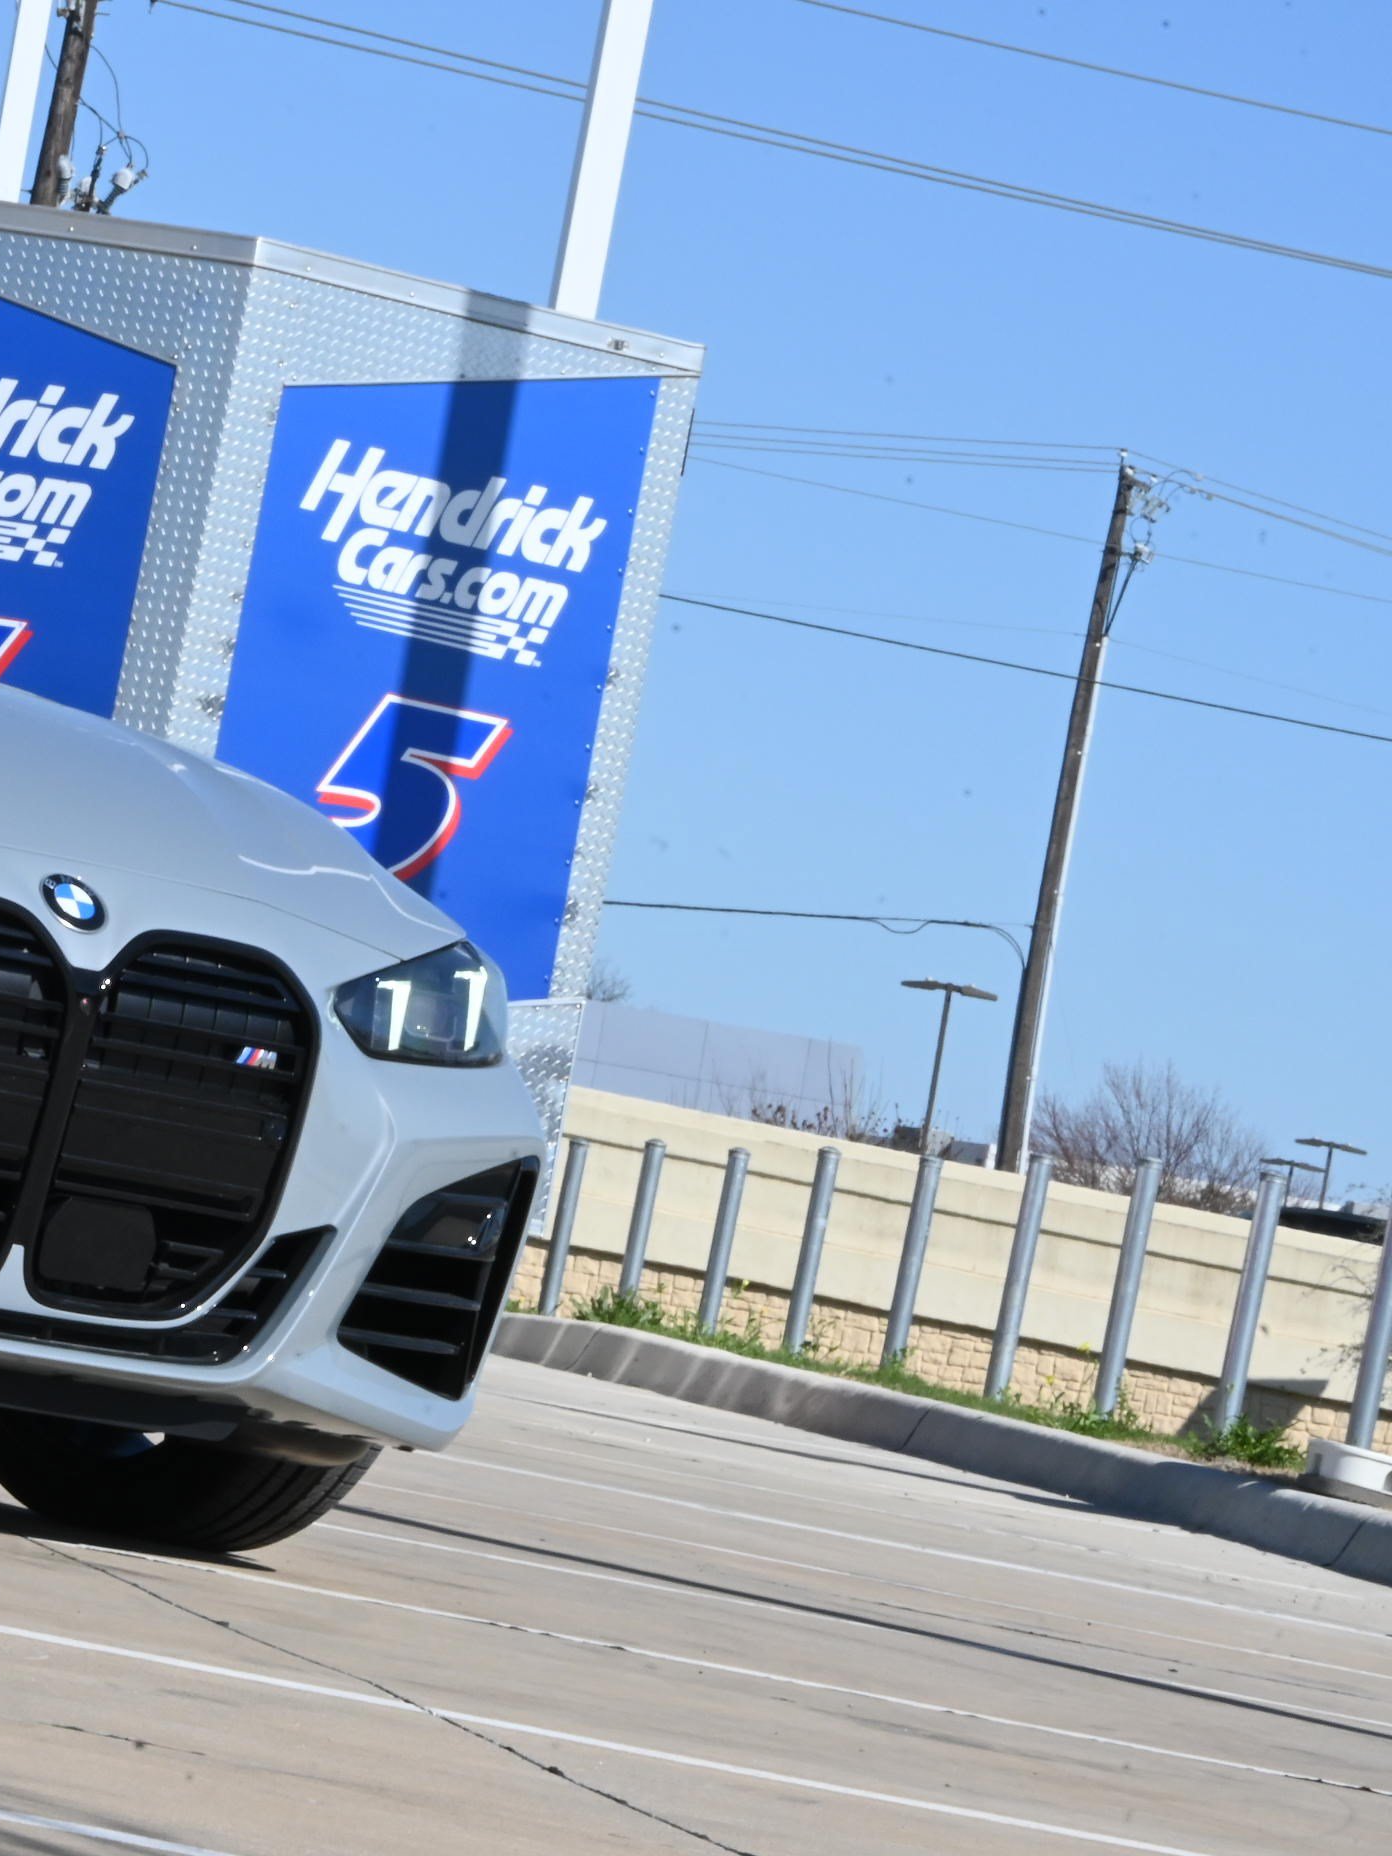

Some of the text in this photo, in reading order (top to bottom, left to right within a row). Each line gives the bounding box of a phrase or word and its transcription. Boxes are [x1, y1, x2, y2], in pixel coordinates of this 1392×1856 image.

[299, 438, 607, 573] Hendrick
[337, 527, 569, 629] Cars.com
[315, 692, 514, 881] 5
